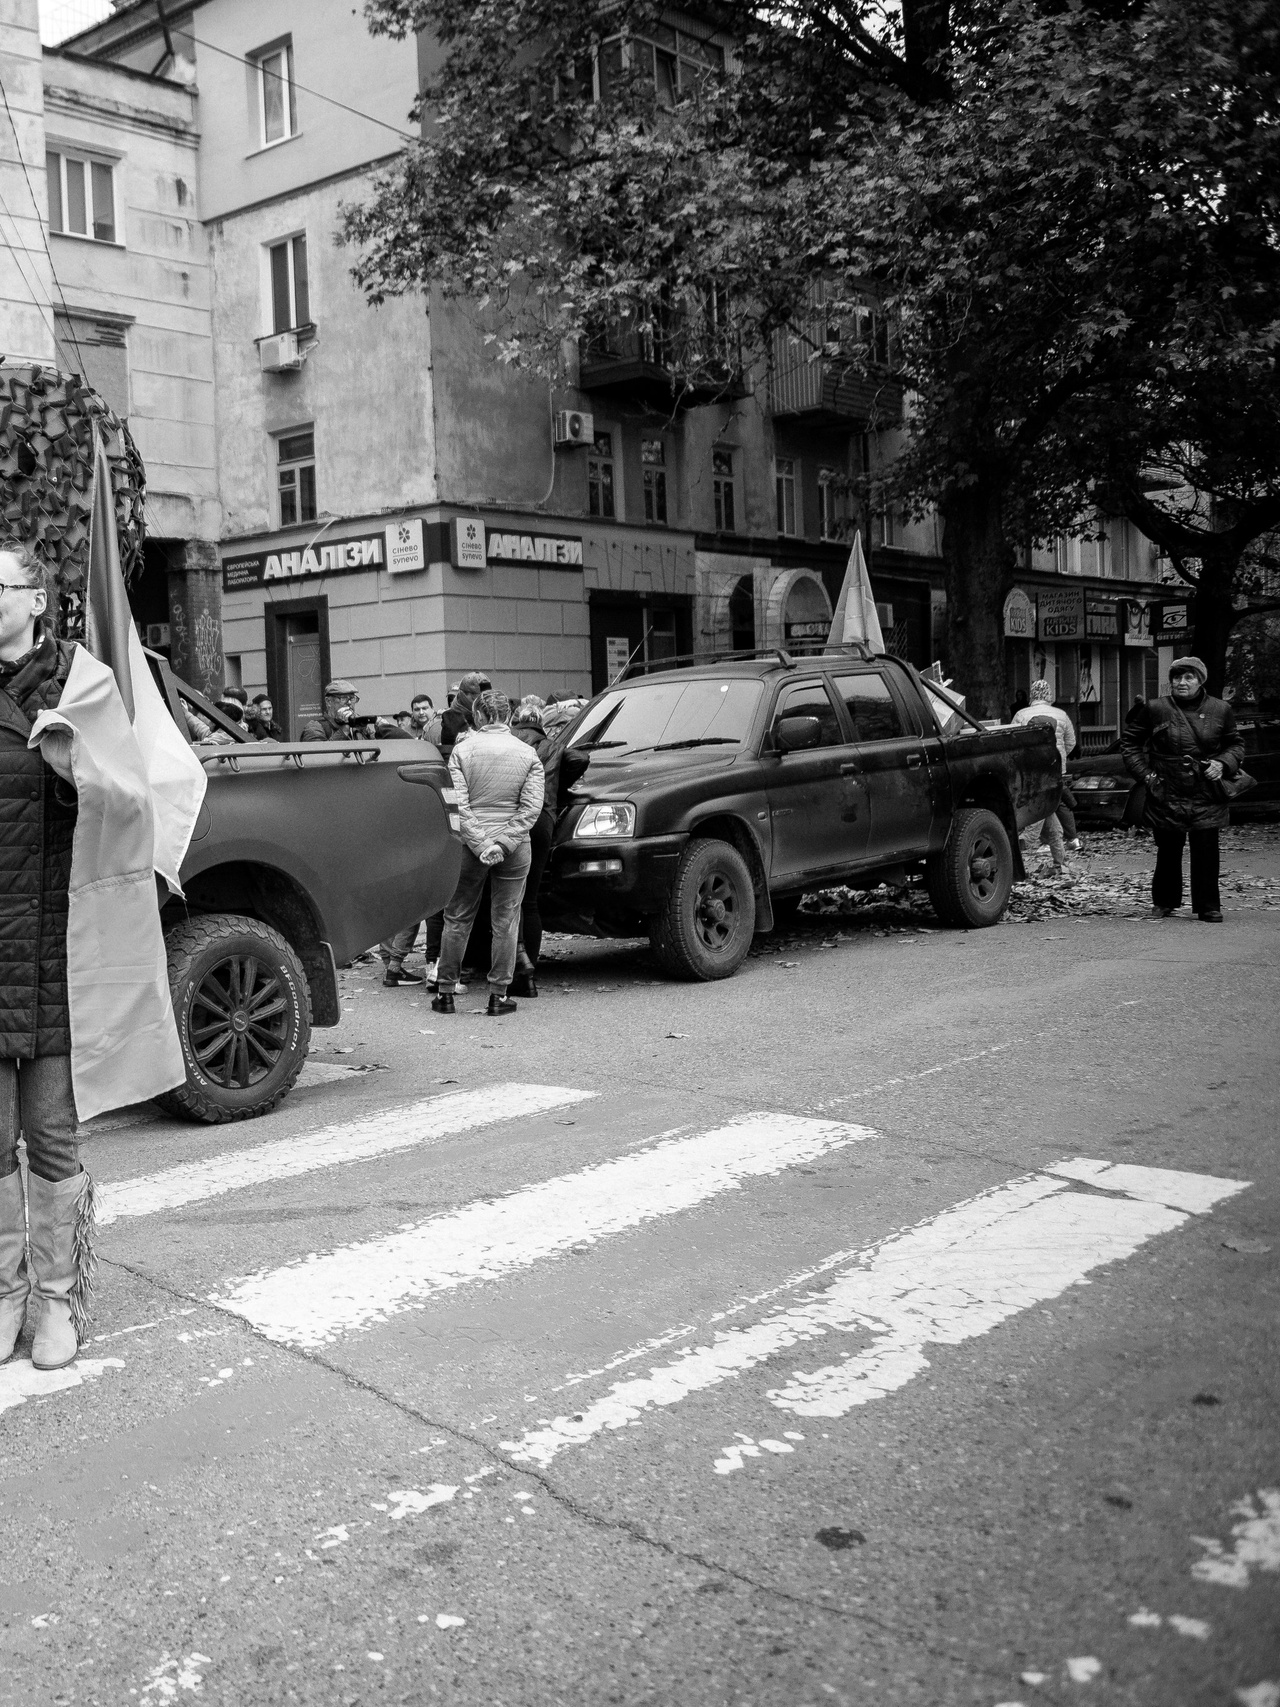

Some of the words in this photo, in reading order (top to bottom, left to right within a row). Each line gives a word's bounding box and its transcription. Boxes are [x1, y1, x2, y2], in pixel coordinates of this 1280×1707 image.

[487, 533, 583, 564] АНАЛІЗИ
[263, 538, 384, 580] АНАЛІЗИ
[393, 555, 419, 566] synevo
[462, 552, 483, 561] synevo
[1042, 591, 1080, 600] МАГАЗИН
[1047, 606, 1075, 614] ОДЯГУ
[1046, 623, 1076, 635] KIDS
[280, 965, 300, 1050] BFGoodrich
